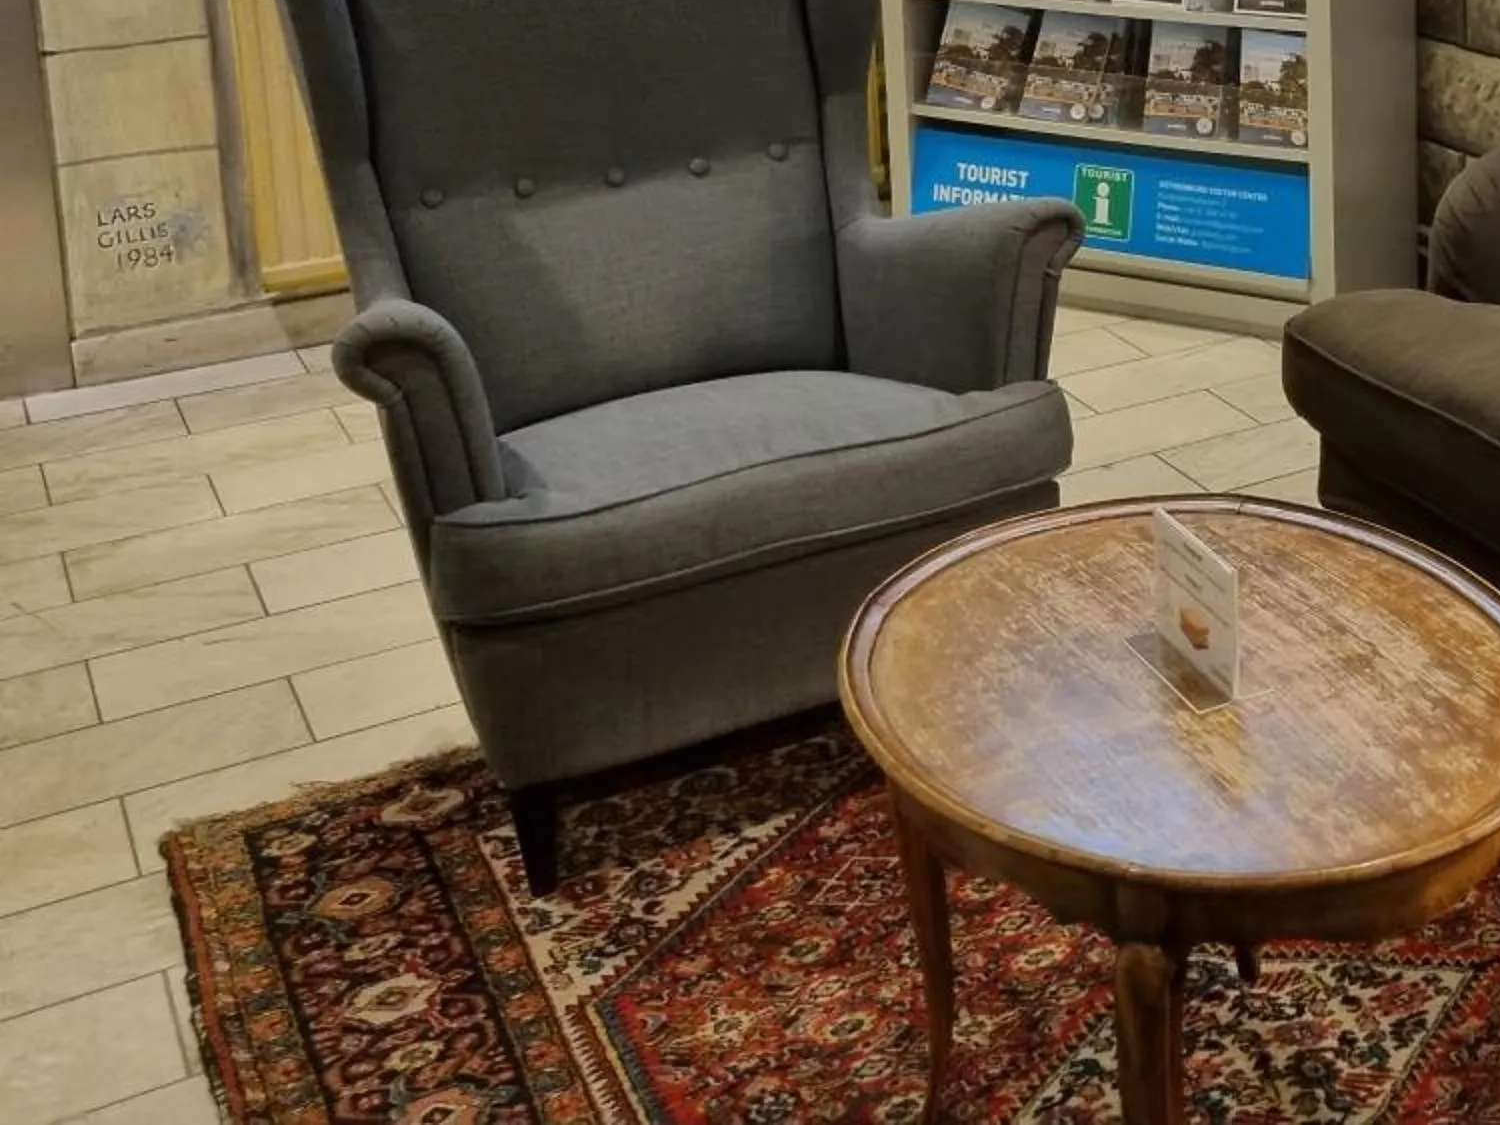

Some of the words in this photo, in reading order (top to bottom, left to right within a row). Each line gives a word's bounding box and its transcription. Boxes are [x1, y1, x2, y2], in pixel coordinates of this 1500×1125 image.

[957, 162, 1031, 189] TOURIST
[1081, 167, 1128, 182] TOURIST
[933, 183, 1030, 206] INFORMA
[97, 202, 157, 228] LARS
[97, 222, 169, 249] GILLIS
[117, 243, 174, 273] 1984
